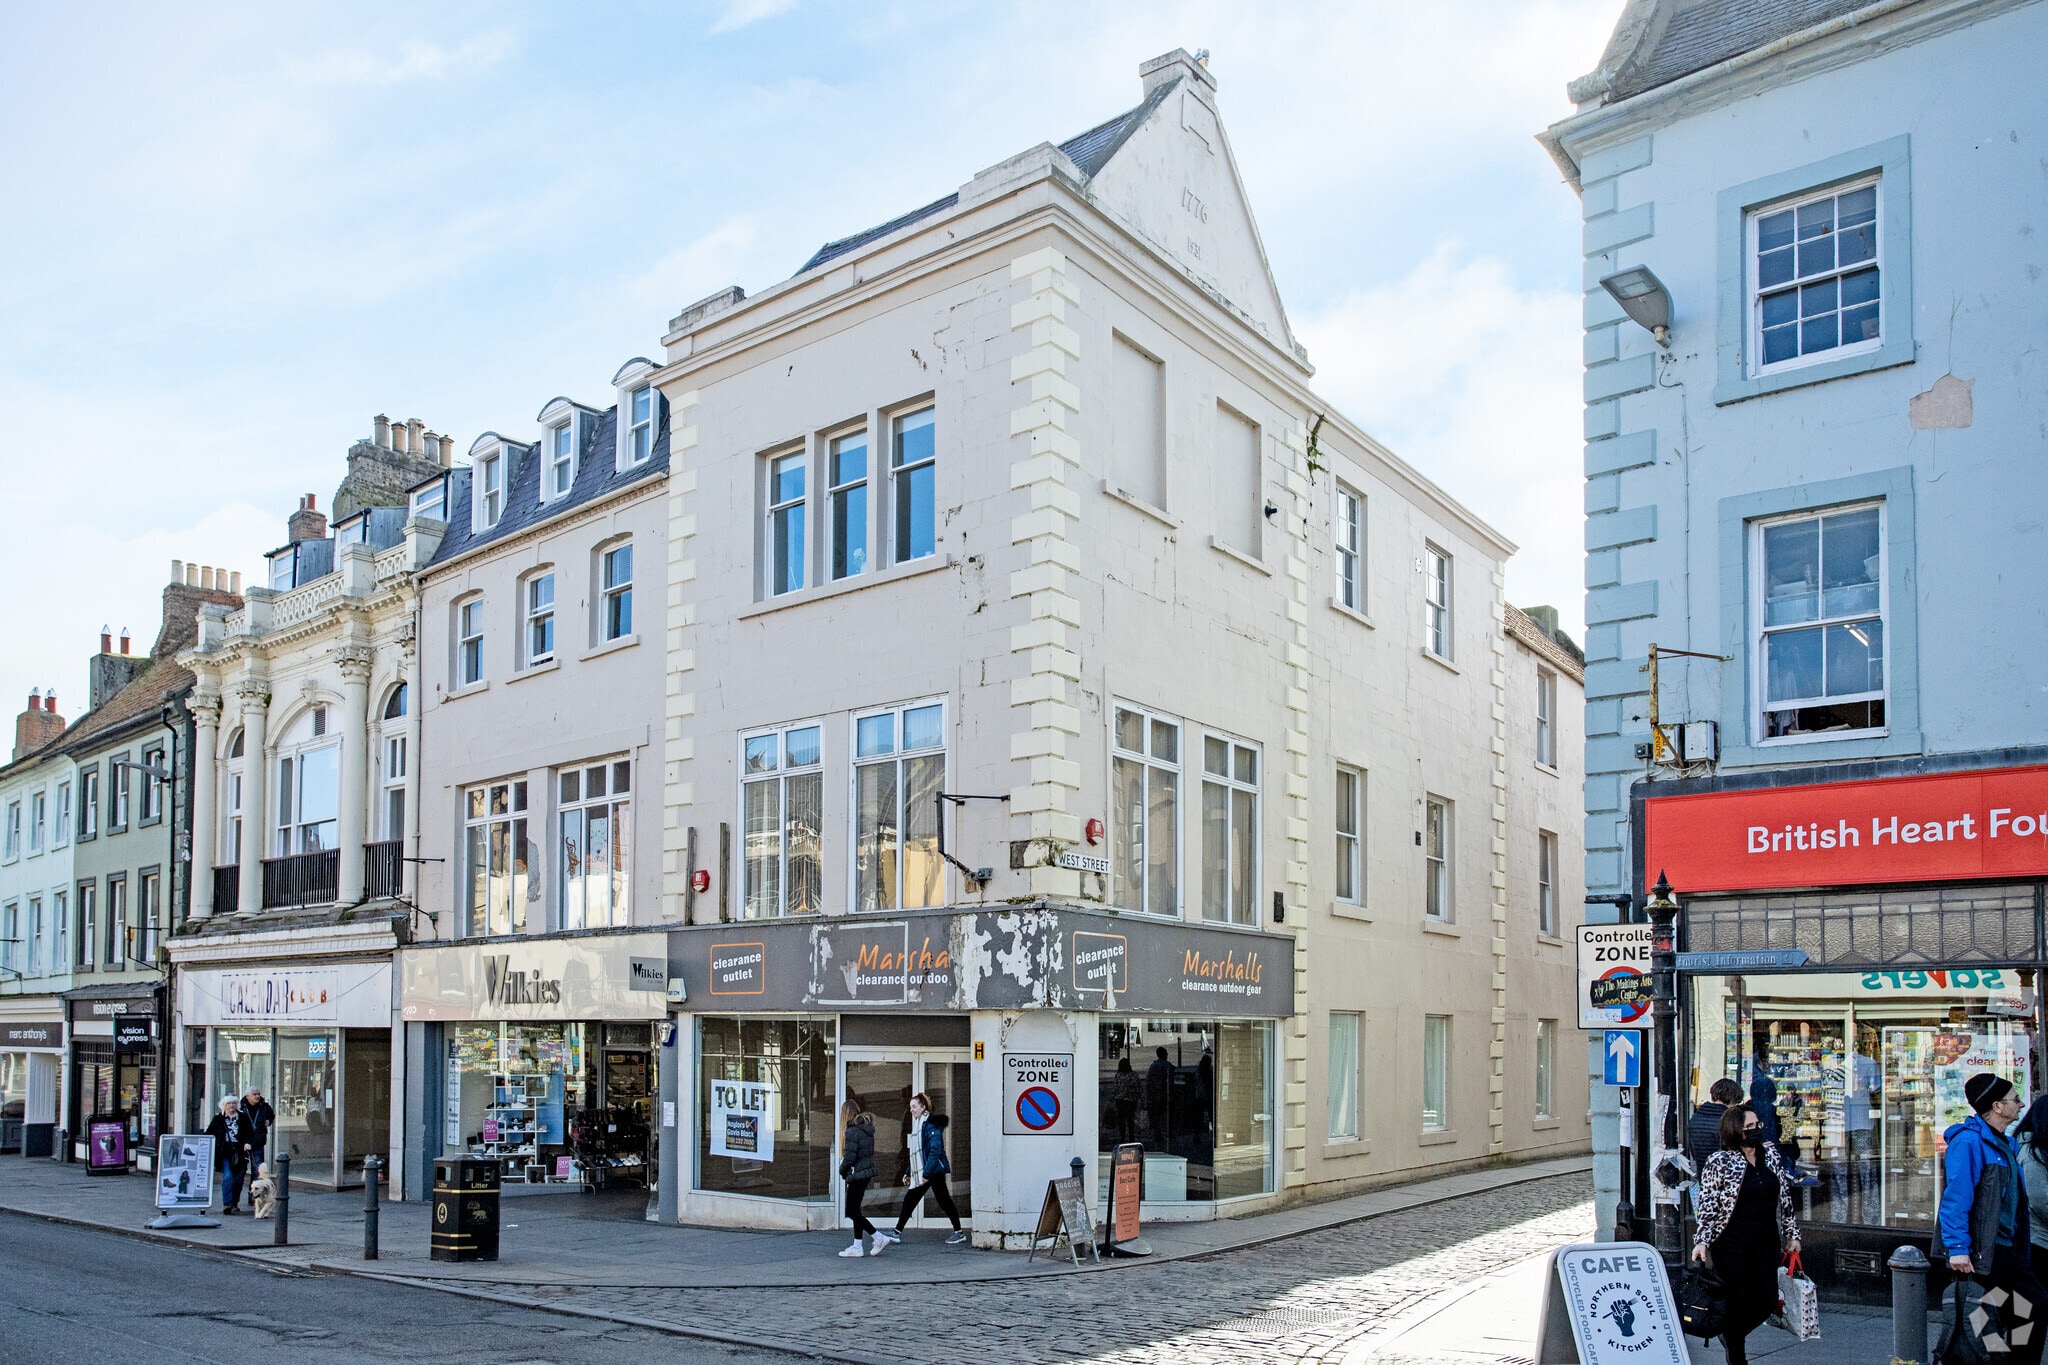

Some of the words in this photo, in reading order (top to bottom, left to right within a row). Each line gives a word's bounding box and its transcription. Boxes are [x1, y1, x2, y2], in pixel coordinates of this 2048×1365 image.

[1182, 187, 1208, 225] 1776
[1748, 819, 1860, 854] British
[1872, 813, 1978, 846] Heart
[1059, 852, 1080, 867] WEST
[1082, 856, 1109, 872] STREET
[1584, 930, 1652, 943] Controlle
[712, 952, 762, 970] clearance
[1076, 943, 1125, 966] clearance
[1595, 945, 1650, 962] ZONE
[1676, 954, 1711, 967] Tourist
[1716, 952, 1776, 966] Information
[632, 963, 664, 979] Wilkies
[1087, 965, 1118, 981] outlet
[1184, 949, 1263, 983] Marshalls
[483, 954, 562, 1007] Wilkies
[722, 968, 753, 983] outlet
[856, 975, 907, 986] clearance
[1182, 980, 1218, 991] clearance
[1219, 983, 1246, 994] outdoor
[1246, 985, 1262, 996] gear
[1603, 980, 1616, 992] The
[229, 979, 290, 1014] CALENDAR
[290, 988, 327, 1004] CLUB
[2009, 1000, 2028, 1011] 99p
[9, 1030, 23, 1039] marc
[117, 1035, 148, 1044] express
[974, 1043, 984, 1059] H
[1966, 1056, 1995, 1066] clear
[1017, 1071, 1059, 1082] ZONE
[715, 1086, 737, 1109] TO
[742, 1088, 766, 1111] LET
[1581, 1256, 1642, 1274] CAFE
[1646, 1257, 1658, 1284] FOOD
[1568, 1262, 1585, 1312] UPCYCLED
[1580, 1314, 1592, 1341] FOOD
[1590, 1282, 1631, 1318] NORTHERN
[1635, 1289, 1656, 1316] SOUL
[1652, 1286, 1669, 1321] EDIBLE
[1607, 1335, 1654, 1352] KITCHEN
[1664, 1323, 1680, 1364] UNSOLD
